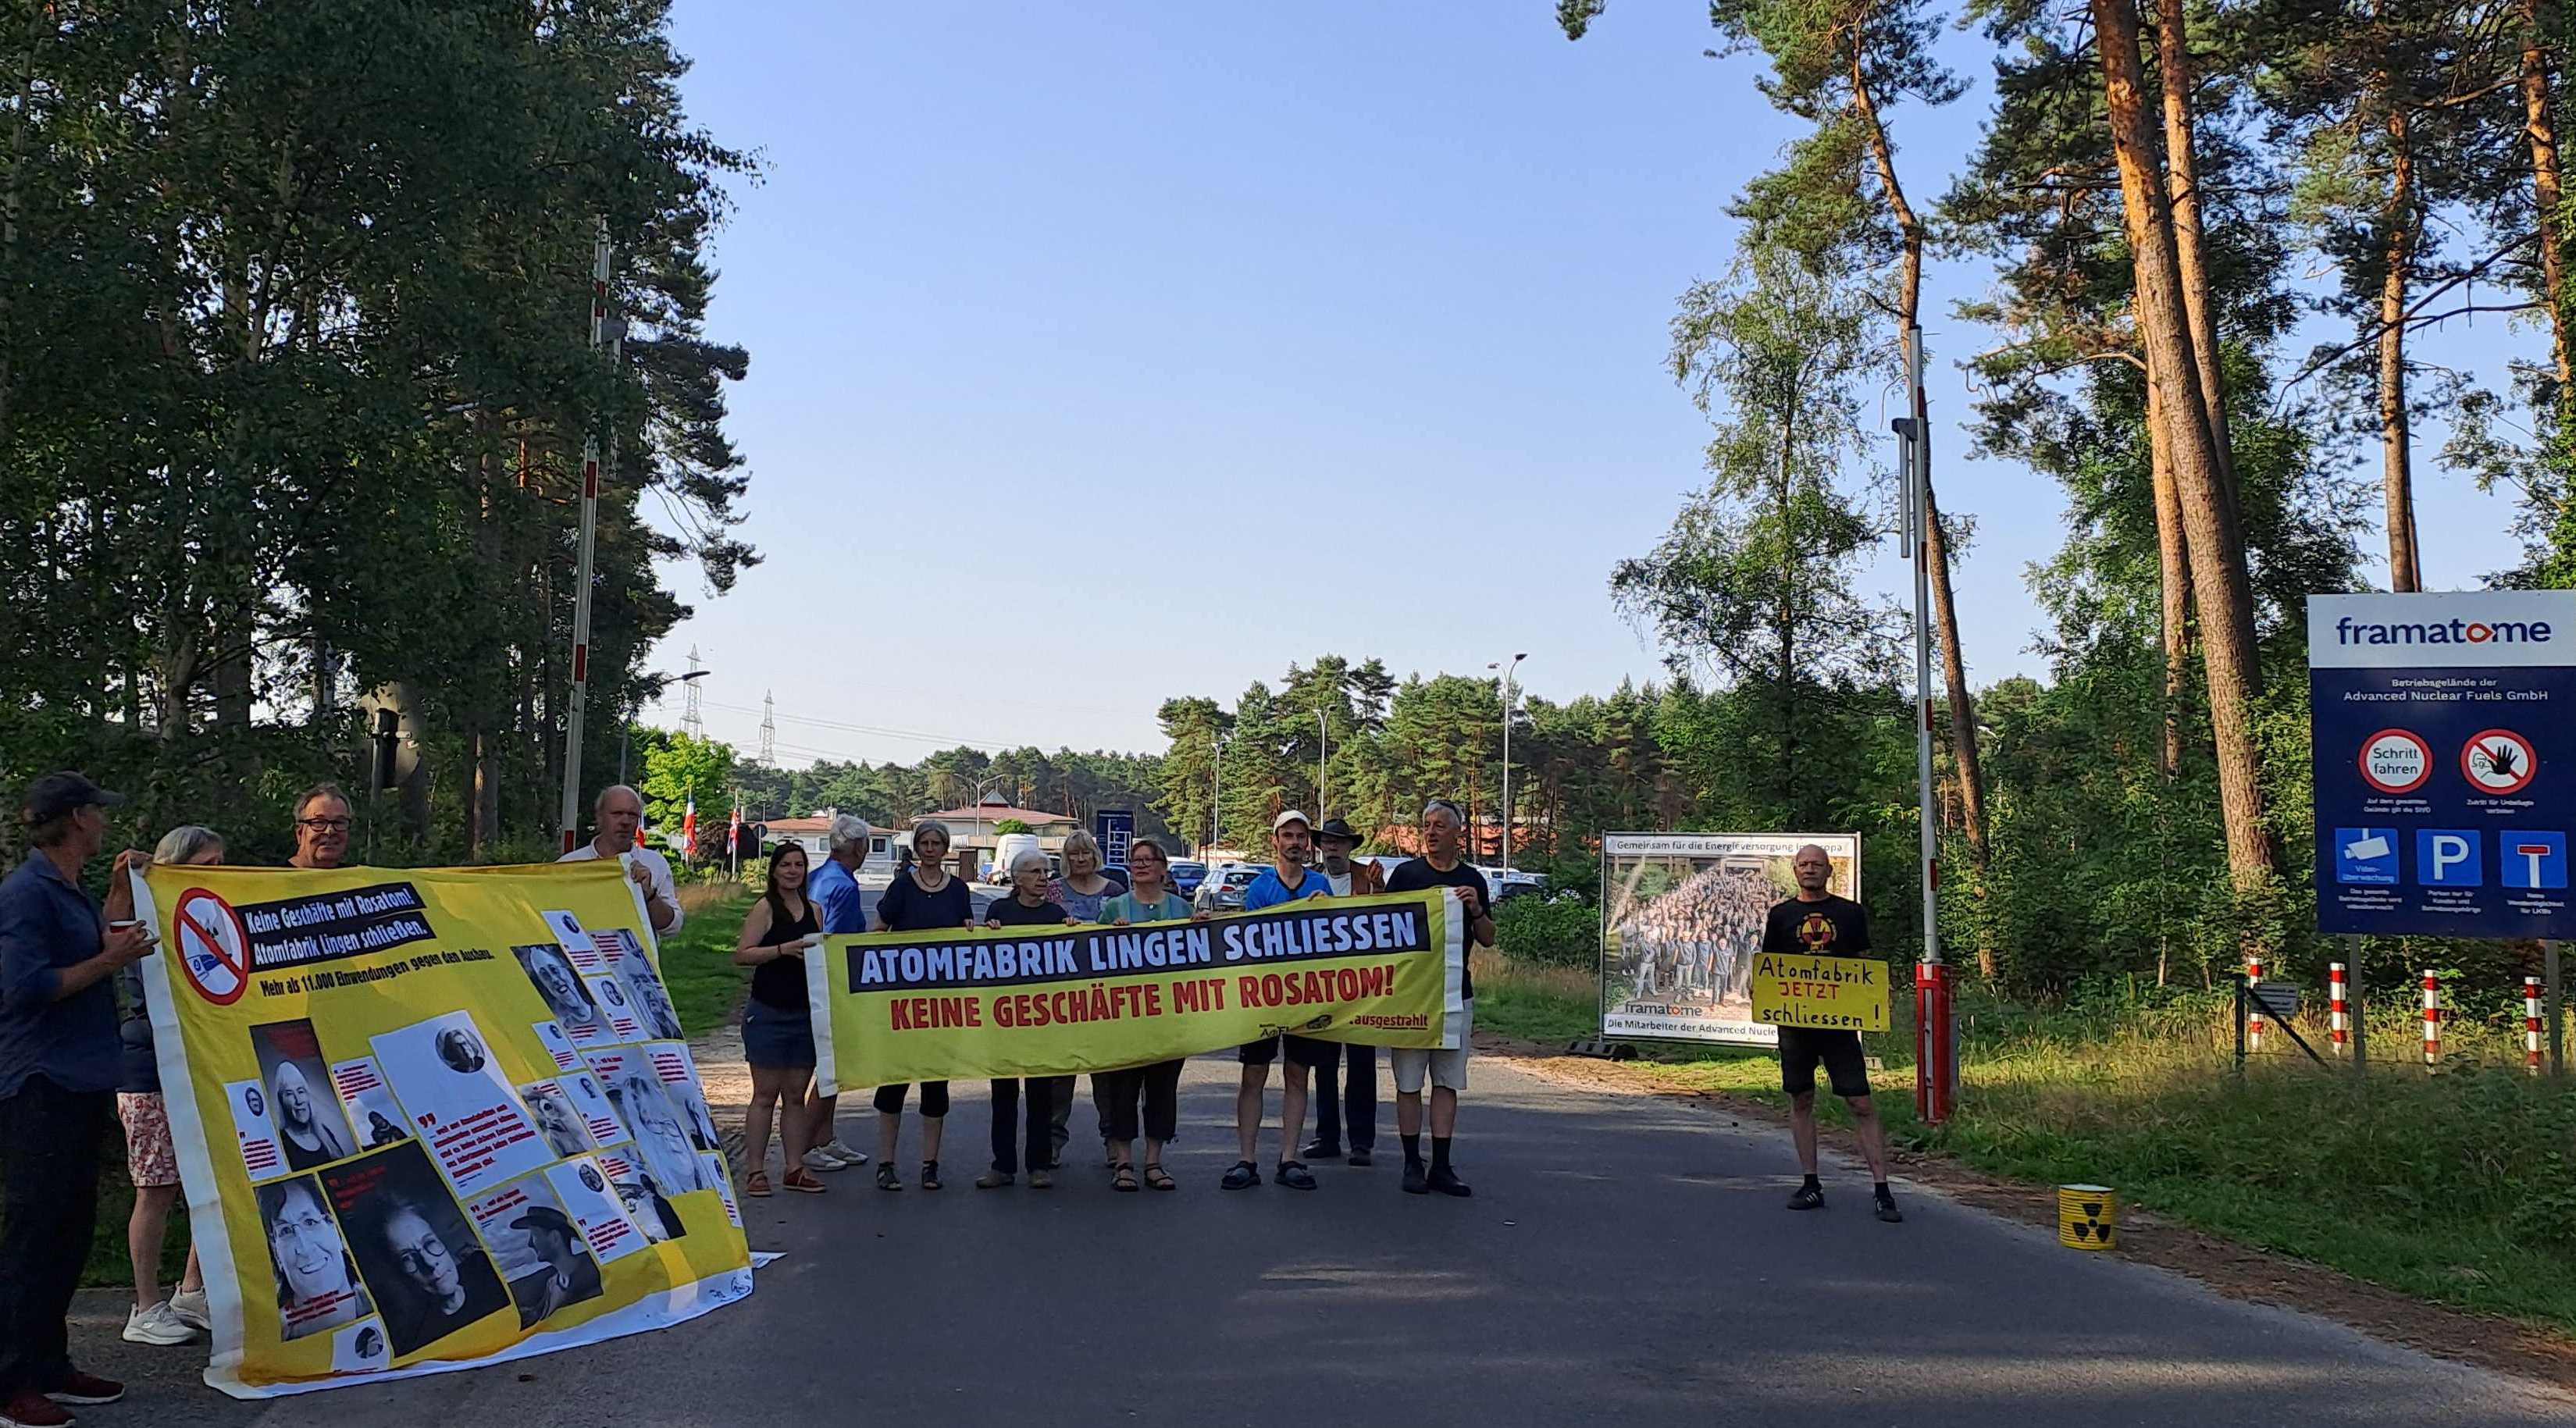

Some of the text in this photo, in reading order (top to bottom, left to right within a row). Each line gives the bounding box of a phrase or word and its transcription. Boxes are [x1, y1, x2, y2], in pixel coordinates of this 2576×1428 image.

[2336, 617, 2552, 645] framatome
[2343, 690, 2549, 701] Advanced Nuclear Fuels GmbH
[2373, 747, 2418, 759] Schritt
[2374, 763, 2418, 775] fahren
[1617, 841, 1670, 849] Gemeinsam
[1673, 841, 1687, 849] für
[1705, 842, 1794, 853] Energieversorgung
[2433, 836, 2468, 879] P
[245, 888, 415, 934] Keine Geschäfte mit Rosatom!
[254, 920, 429, 965] Atomfabrik Lingen schließen.
[860, 911, 1416, 985] ATOMFABRIK LINGEN SCHLIESSEN
[260, 978, 285, 997] Mehr
[286, 977, 301, 994] als
[301, 973, 335, 992] 11.000
[334, 960, 411, 986] Einwendungen
[409, 954, 443, 970] gegen
[441, 951, 461, 963] den
[1758, 956, 1874, 985] Atomfabrik
[890, 964, 1395, 1031] KEINE GESCHÄFTE MIT ROSATOM!
[1777, 981, 1840, 999] JETZT
[1625, 1001, 1703, 1016] framatome
[1762, 1002, 1863, 1027] schliessen
[1349, 1013, 1428, 1030] .ausgestrahlt
[1607, 1019, 1623, 1028] Die
[1624, 1019, 1678, 1031] Mitarbeiter
[1680, 1023, 1696, 1031] der
[1698, 1024, 1746, 1034] Advanced
